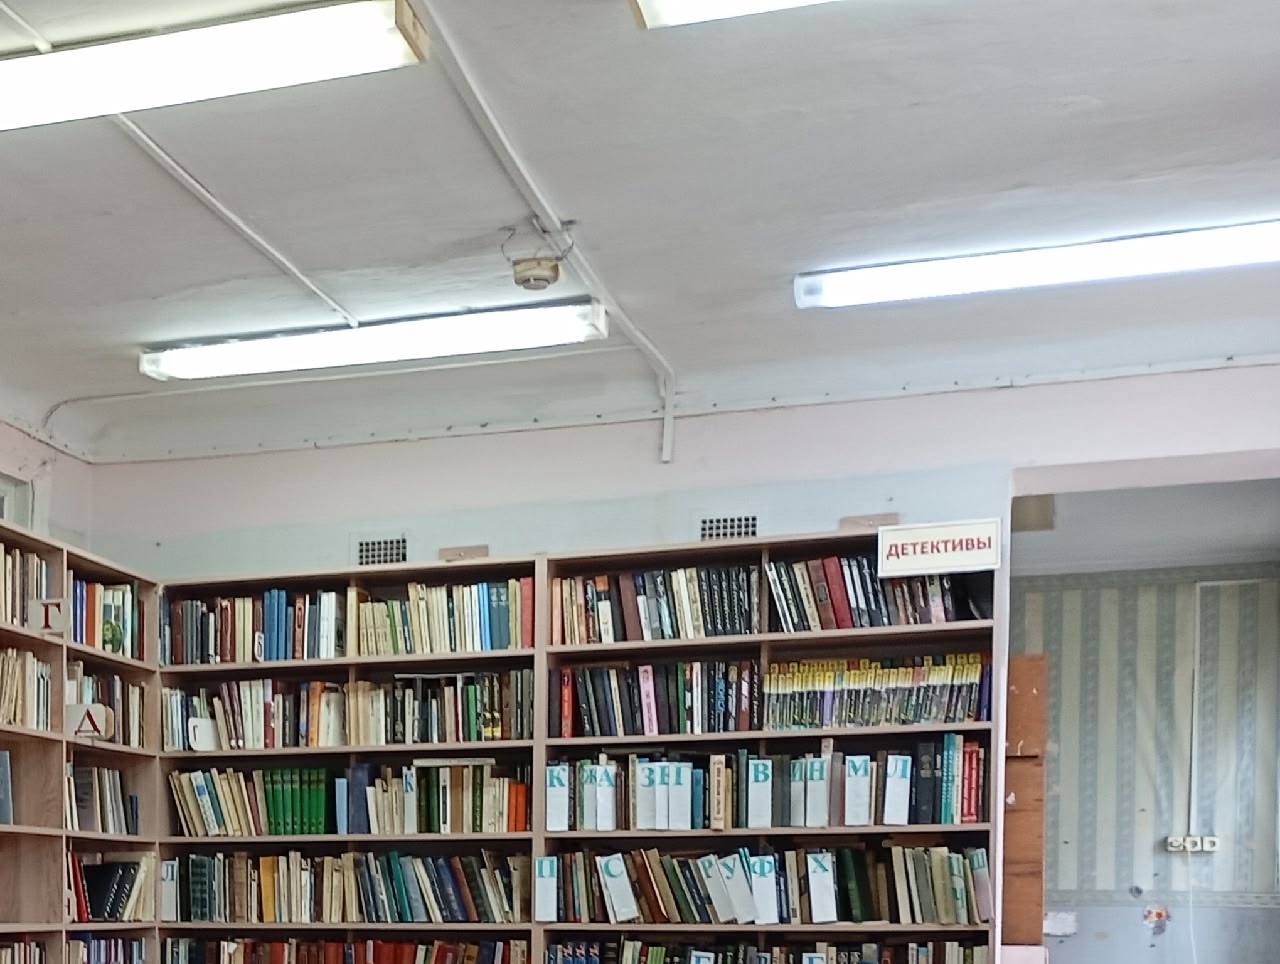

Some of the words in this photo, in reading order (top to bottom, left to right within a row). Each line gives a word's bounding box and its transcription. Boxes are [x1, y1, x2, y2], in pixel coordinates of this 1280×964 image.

[886, 536, 992, 560] ДЕТЕКТИВЫ
[40, 602, 61, 629] Г
[549, 767, 566, 787] К
[599, 767, 616, 787] А
[753, 762, 770, 783] В
[808, 760, 825, 781] Н
[847, 760, 869, 777] М
[887, 759, 908, 778] Л
[537, 858, 555, 878] П
[604, 857, 624, 879] С
[701, 859, 715, 879] Р
[719, 856, 738, 879] У
[751, 858, 775, 878] Ф
[810, 854, 830, 874] Х
